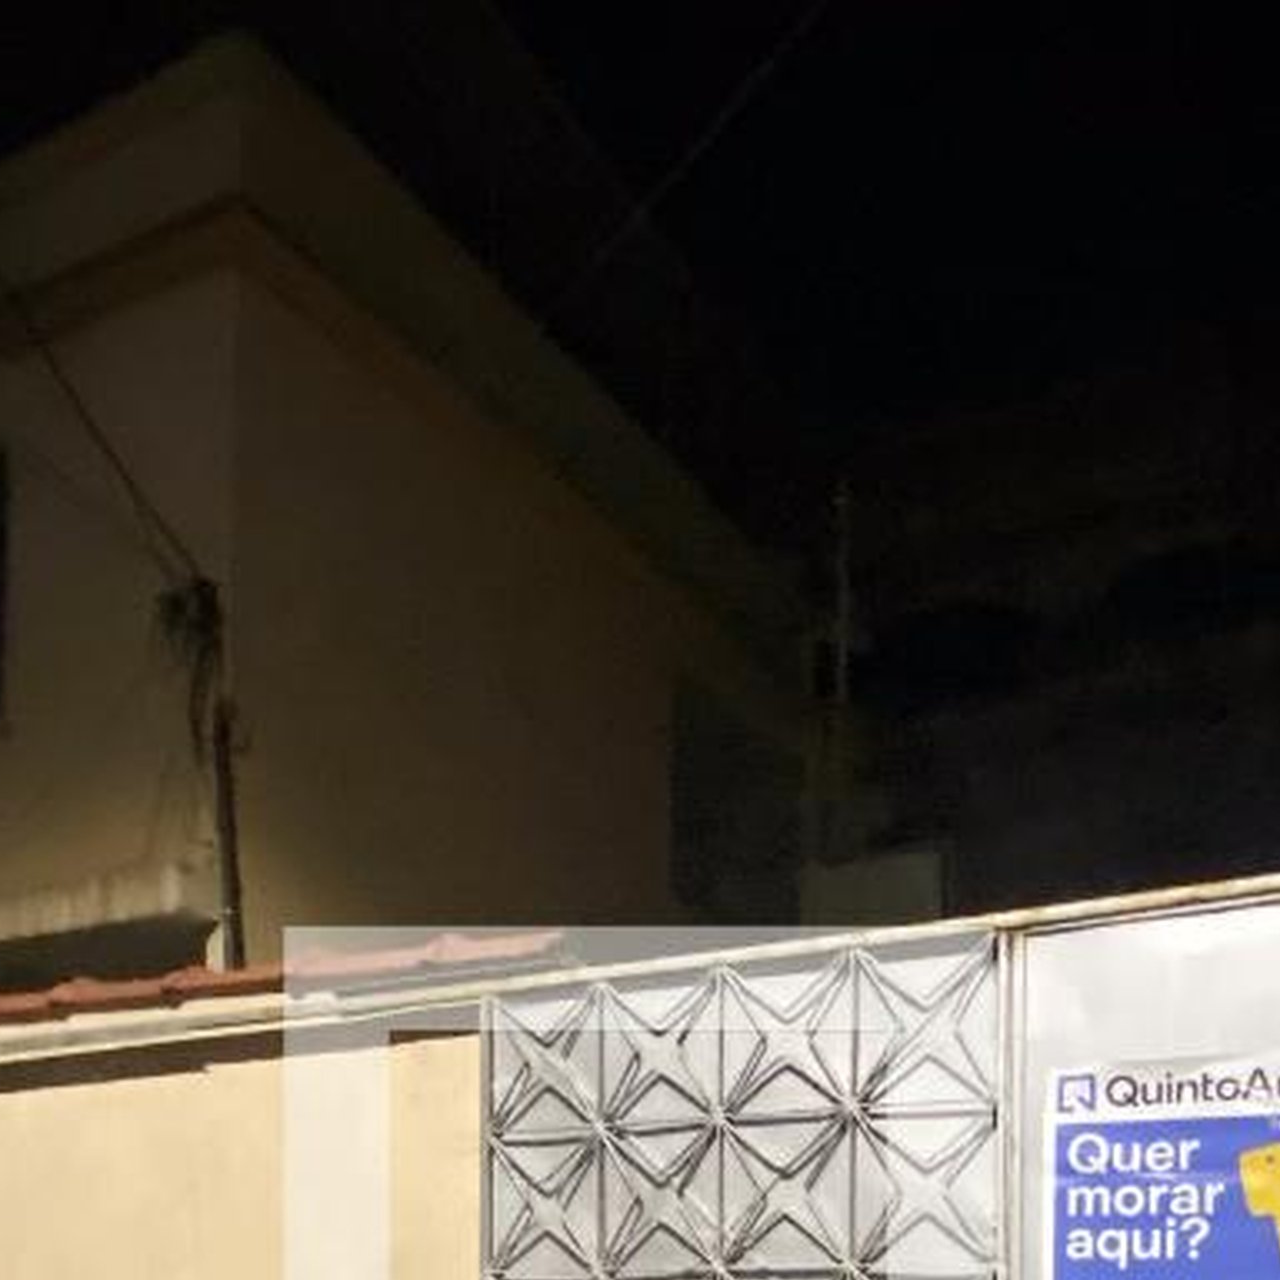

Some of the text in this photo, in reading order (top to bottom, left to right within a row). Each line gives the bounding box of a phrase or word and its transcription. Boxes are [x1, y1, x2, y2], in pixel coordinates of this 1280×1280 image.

[1067, 1132, 1200, 1174] Quer
[1066, 1182, 1224, 1217] morar
[1065, 1217, 1210, 1269] aqui?
